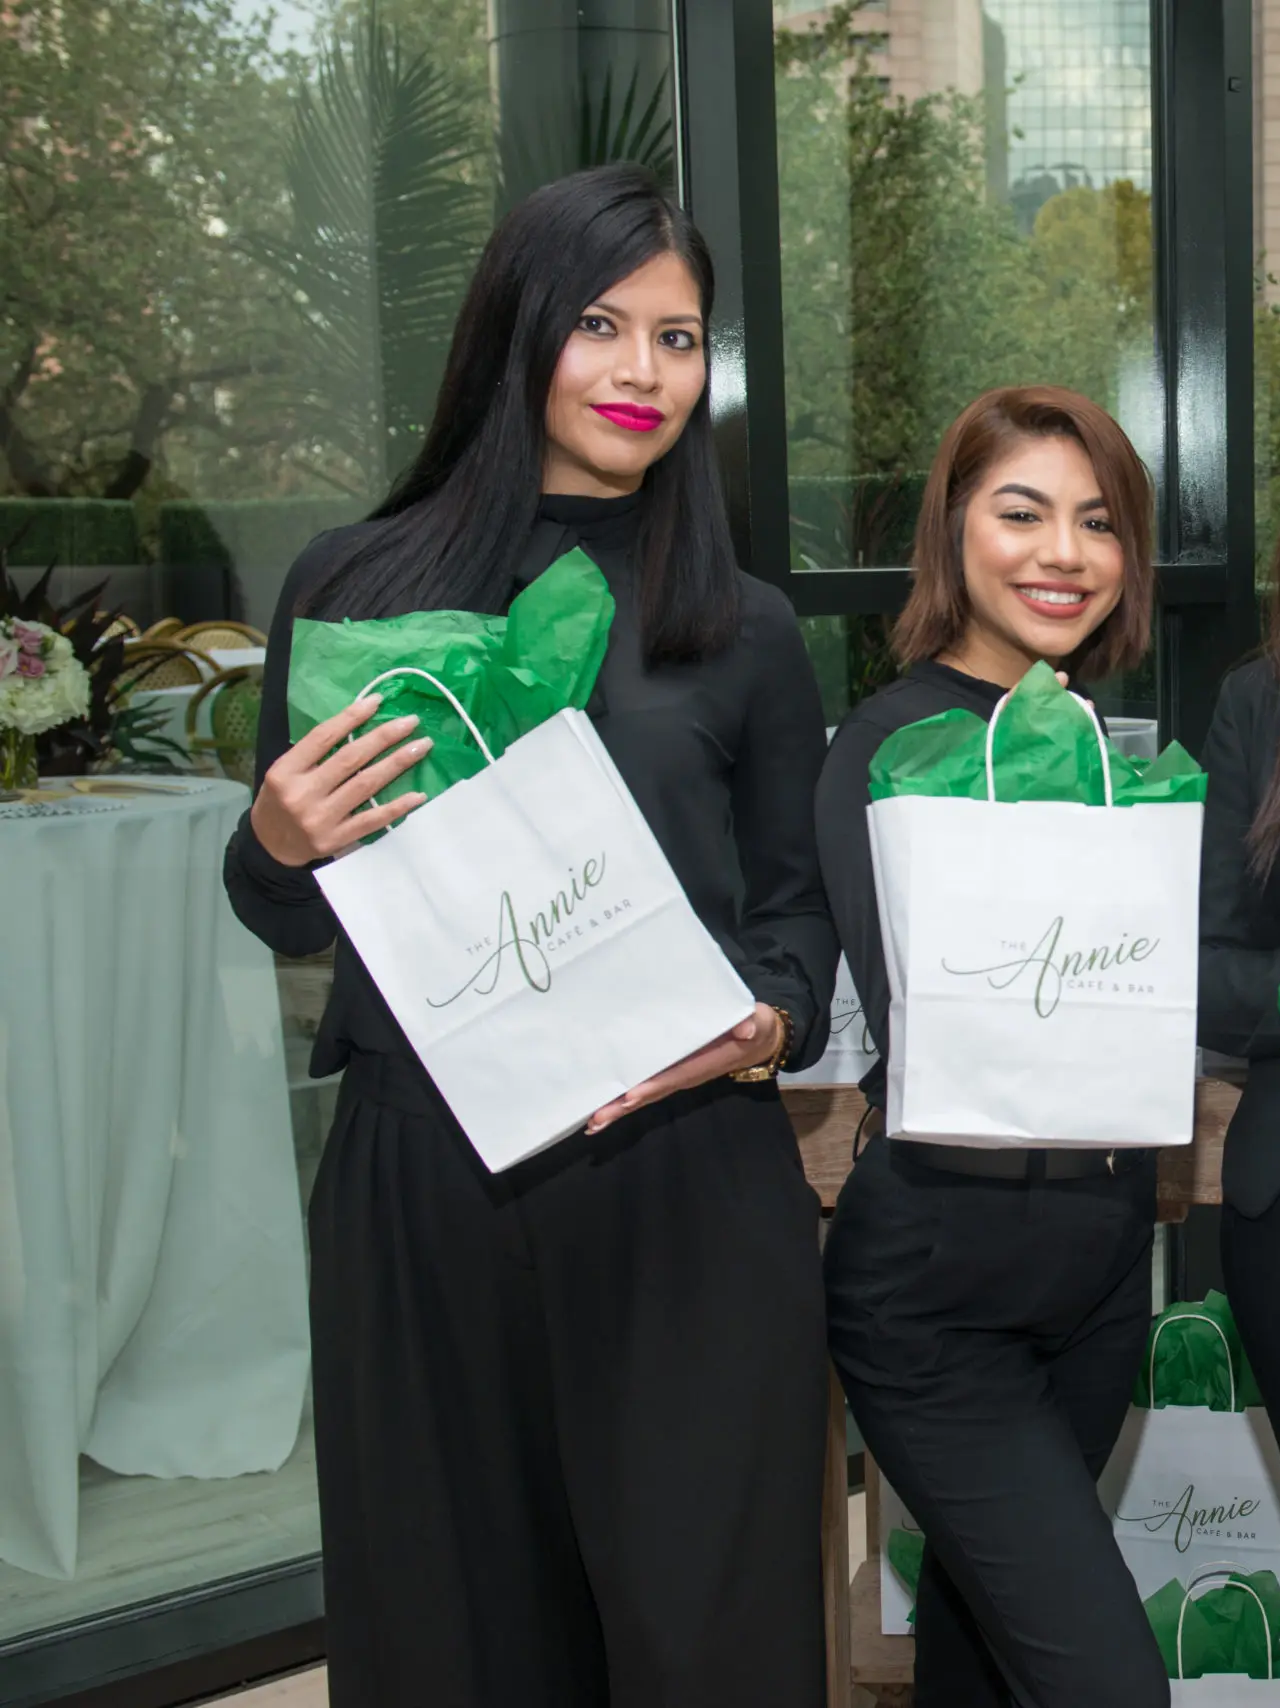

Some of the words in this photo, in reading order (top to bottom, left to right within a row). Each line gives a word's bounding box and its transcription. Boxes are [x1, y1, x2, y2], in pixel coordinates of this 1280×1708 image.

[589, 918, 600, 929] &
[603, 898, 633, 920] BAR
[426, 851, 607, 1008] Annie
[466, 936, 494, 956] THE
[1000, 939, 1028, 952] THE
[941, 915, 1161, 1018] Annie
[1112, 982, 1120, 992] &
[1128, 983, 1154, 993] BAR
[835, 998, 857, 1006] THE
[1152, 1499, 1171, 1508] THE
[1115, 1484, 1260, 1553] Annie
[1237, 1531, 1256, 1540] BAR
